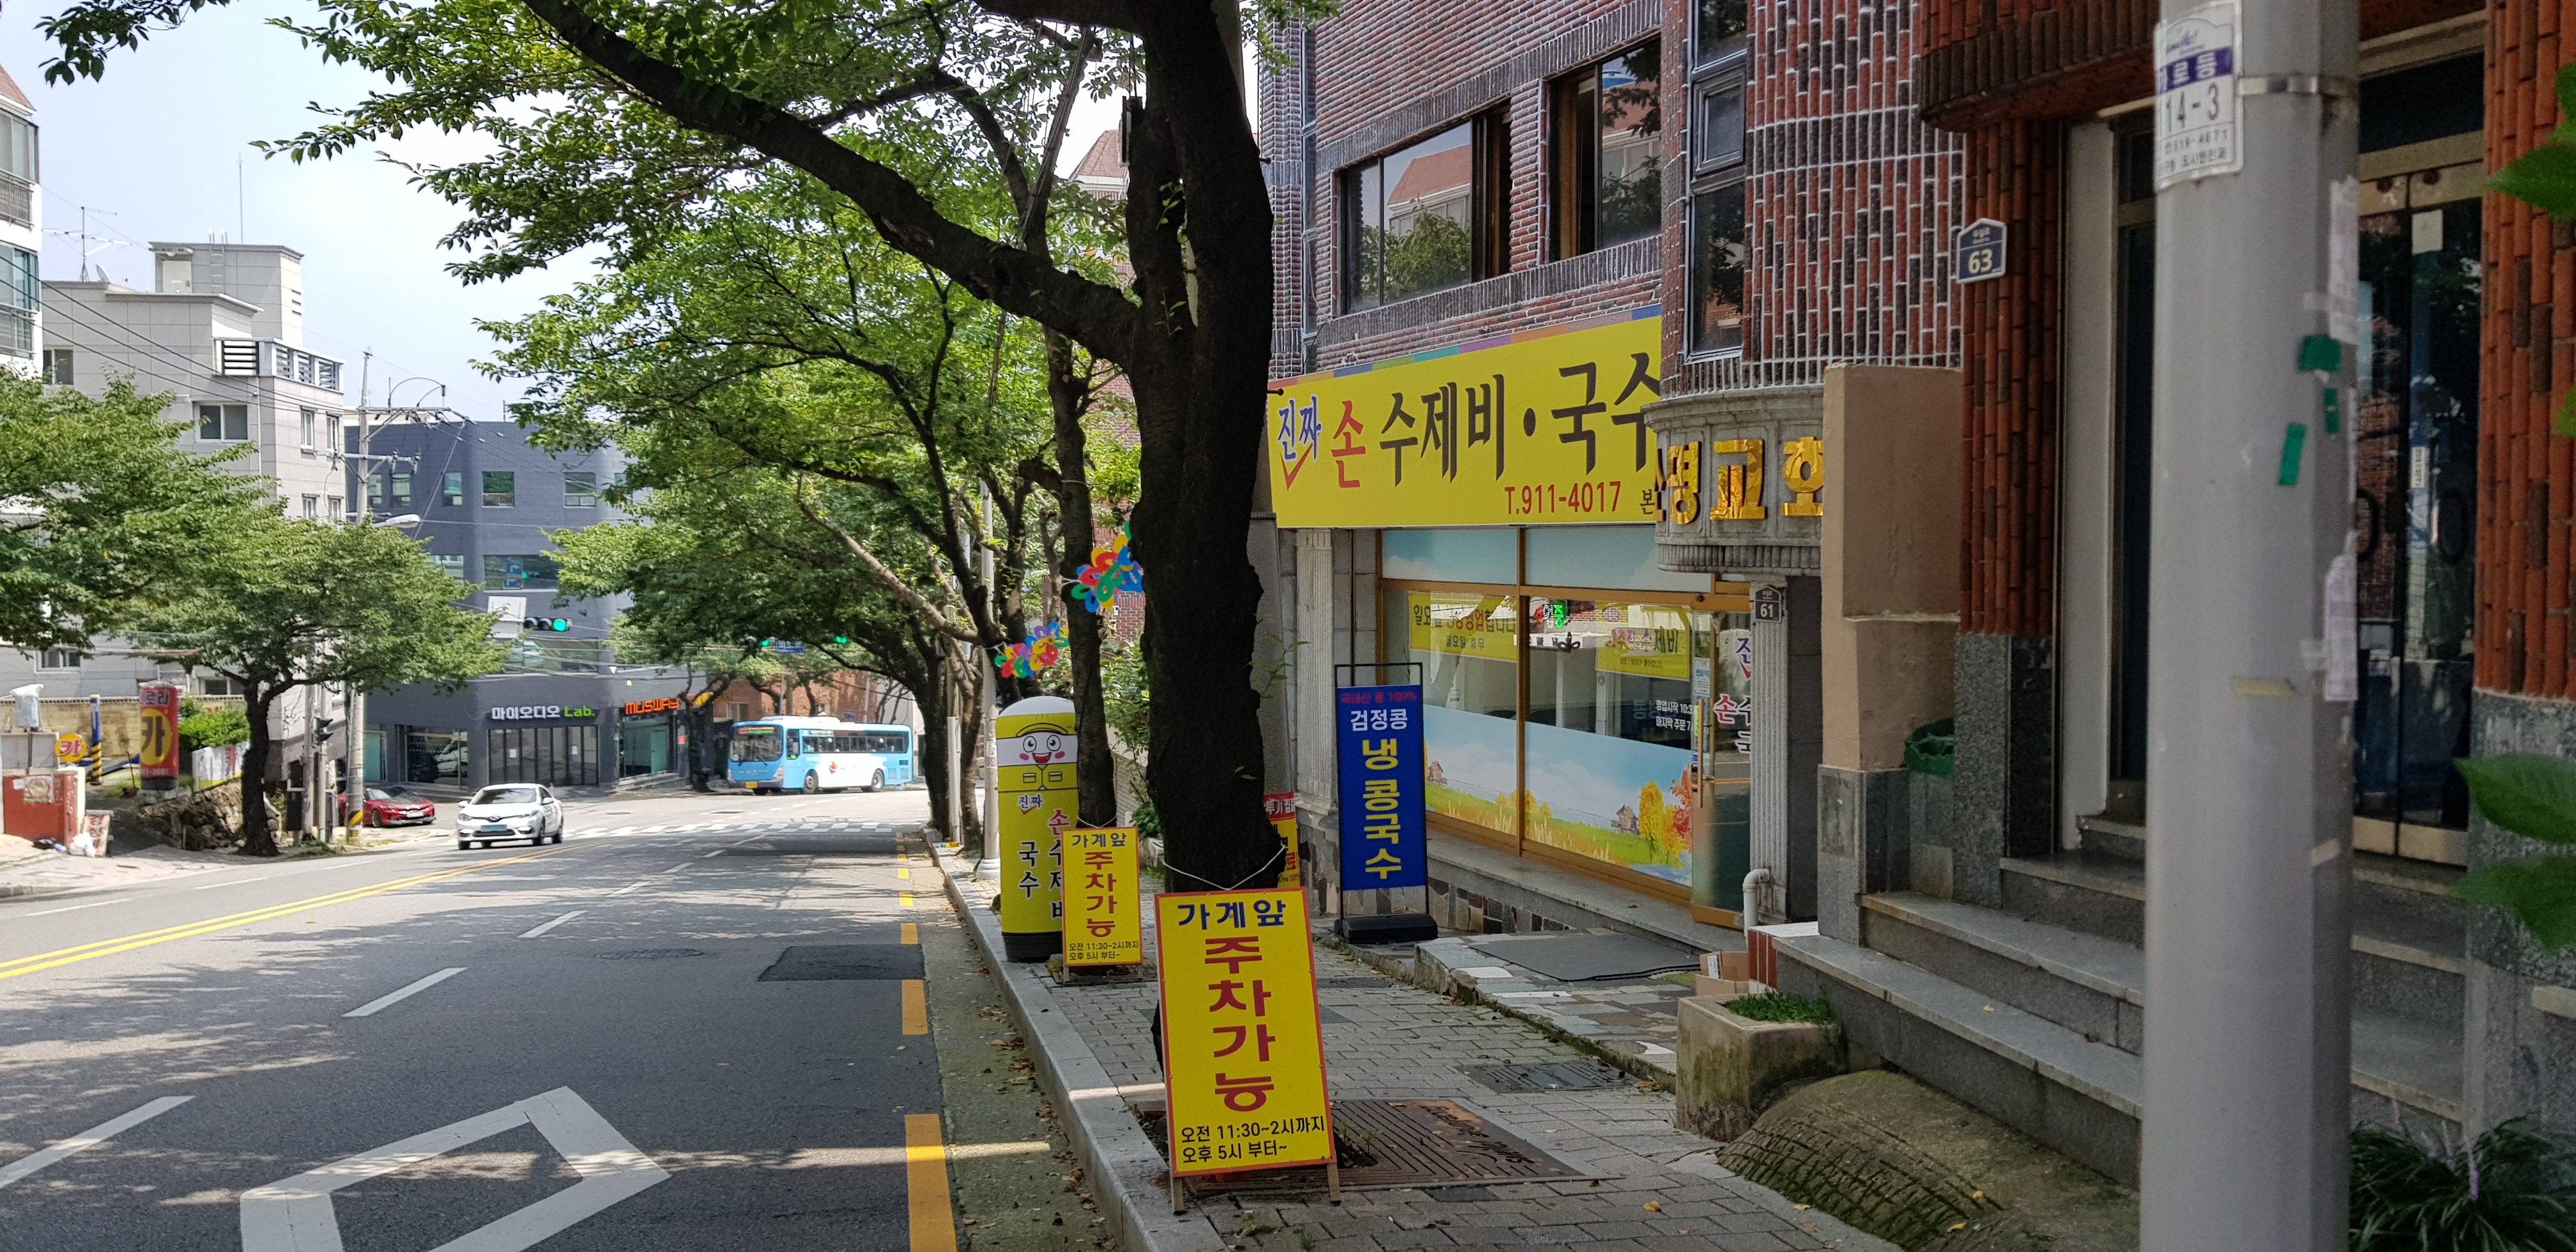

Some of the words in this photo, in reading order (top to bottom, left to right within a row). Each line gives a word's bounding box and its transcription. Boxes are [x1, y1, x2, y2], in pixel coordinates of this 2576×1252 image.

[1968, 248, 1993, 274] 63
[1278, 393, 1321, 462] 진짜
[1331, 400, 1366, 489] 손
[1505, 481, 1621, 515] T.911-4017
[1760, 604, 1774, 618] 61
[491, 705, 560, 720] 마이오디오
[564, 705, 595, 717] Lab.
[1656, 699, 1679, 714] 영업시작
[1351, 708, 1408, 731] 검정콩
[1655, 716, 1674, 729] 마지막
[1674, 718, 1686, 731] 주문
[59, 739, 82, 756] 카
[1018, 795, 1043, 809] 진짜
[1019, 841, 1039, 899] 국수
[1085, 851, 1117, 938] 주차가능
[1070, 943, 1084, 951] 오전
[1087, 940, 1139, 950] 11:30~2시까지
[1070, 952, 1084, 960] 오후
[1087, 951, 1098, 960] 5시
[1204, 936, 1276, 1112] 주차가능
[1181, 1125, 1211, 1144] 오전
[1217, 1115, 1324, 1140] 11:30~2시까지
[1183, 1146, 1213, 1164] 오후
[1218, 1142, 1242, 1160] 5시
[1248, 1139, 1287, 1158] 부터~
